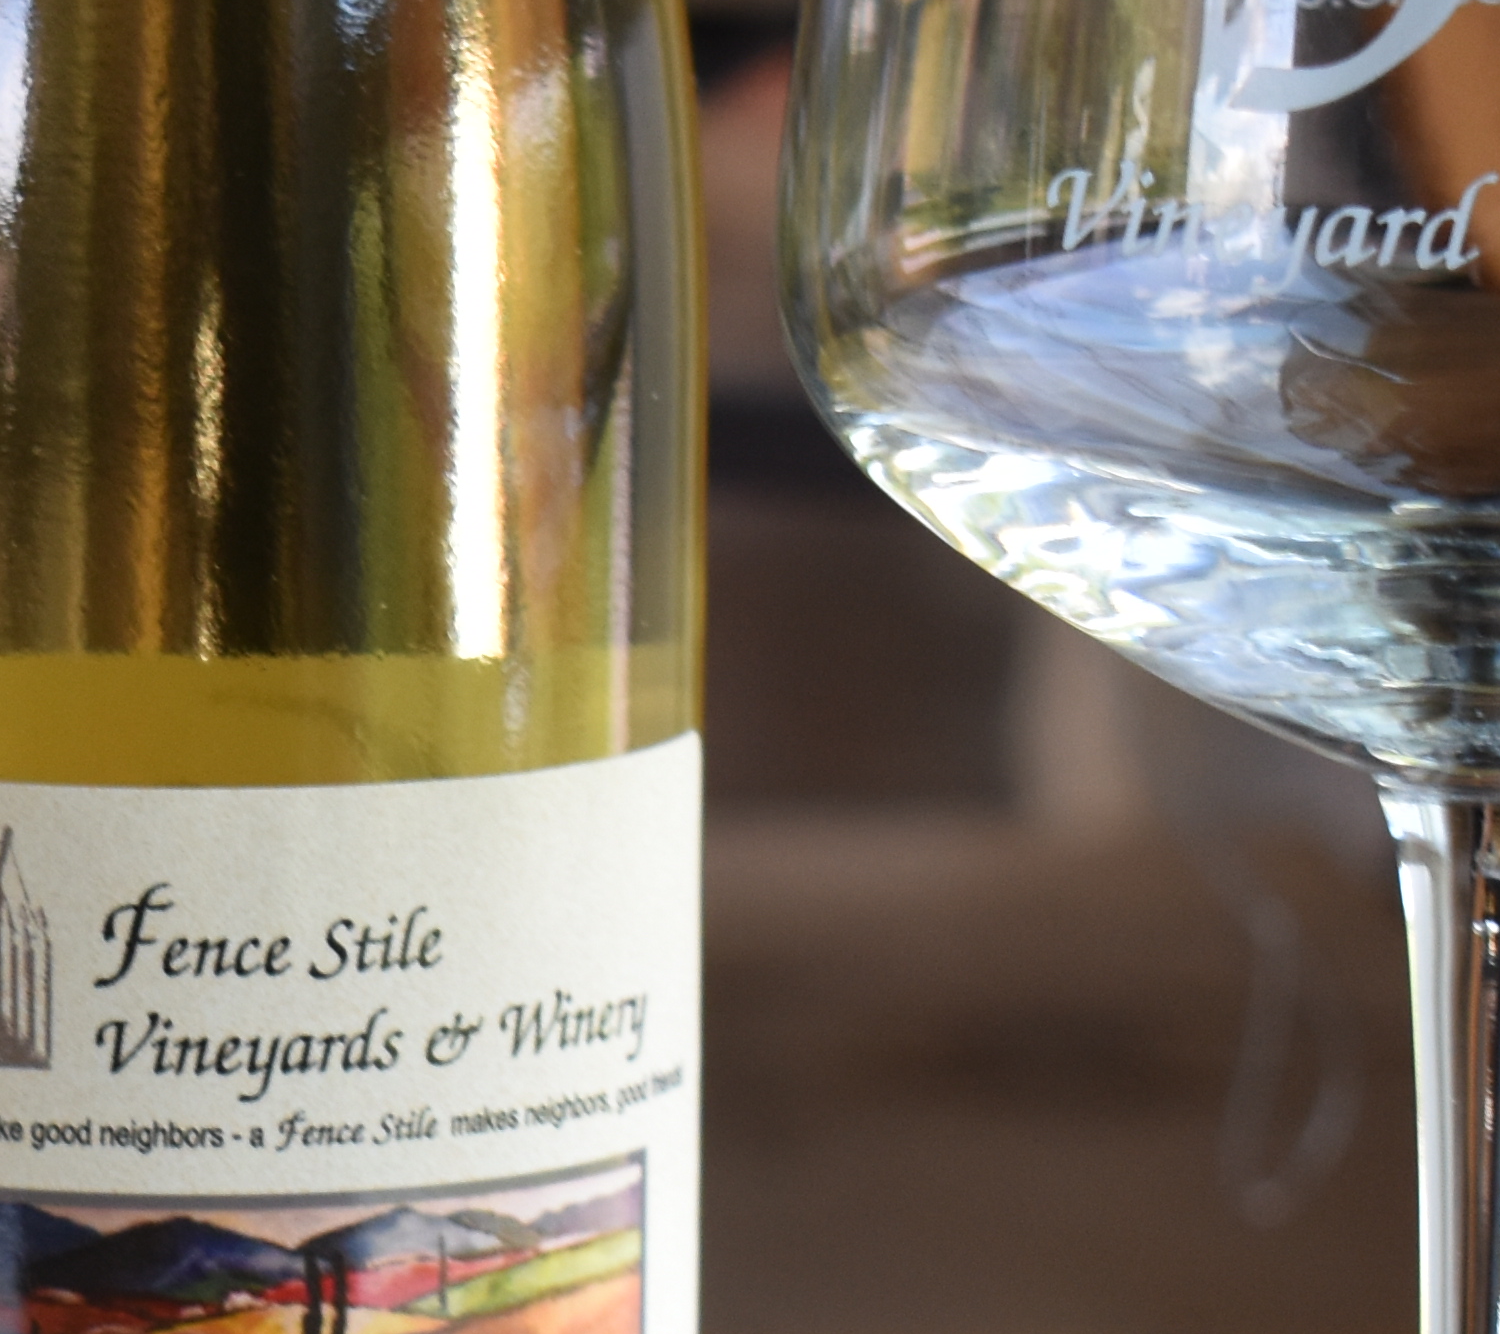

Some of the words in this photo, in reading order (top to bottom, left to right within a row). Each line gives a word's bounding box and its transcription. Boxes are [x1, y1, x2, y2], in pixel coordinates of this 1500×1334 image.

[1046, 162, 1499, 299] Vineyard
[93, 880, 292, 989] Fence
[306, 904, 444, 981] Stile
[93, 1007, 404, 1104] Vineyards
[425, 1011, 485, 1067] &
[499, 988, 650, 1062] Winery
[30, 1118, 93, 1151] good
[99, 1120, 225, 1154] neighbors
[248, 1129, 265, 1148] a
[275, 1109, 365, 1152] Fence
[371, 1104, 439, 1146] Stile
[450, 1105, 520, 1137] makes
